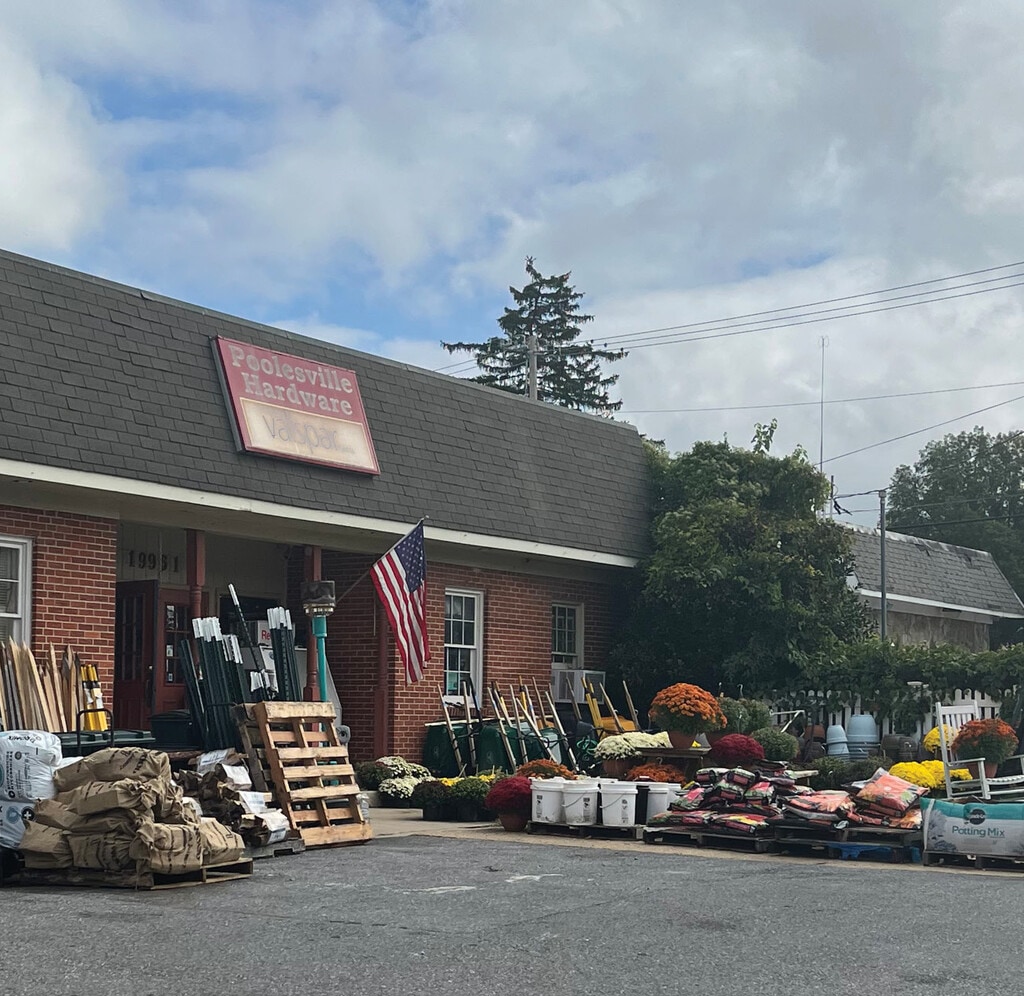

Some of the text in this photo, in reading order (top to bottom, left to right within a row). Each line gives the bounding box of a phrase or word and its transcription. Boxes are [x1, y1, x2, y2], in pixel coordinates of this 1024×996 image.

[228, 344, 353, 394] Poolesville
[241, 372, 353, 416] Hardware
[952, 825, 1006, 838] Potting Mix
